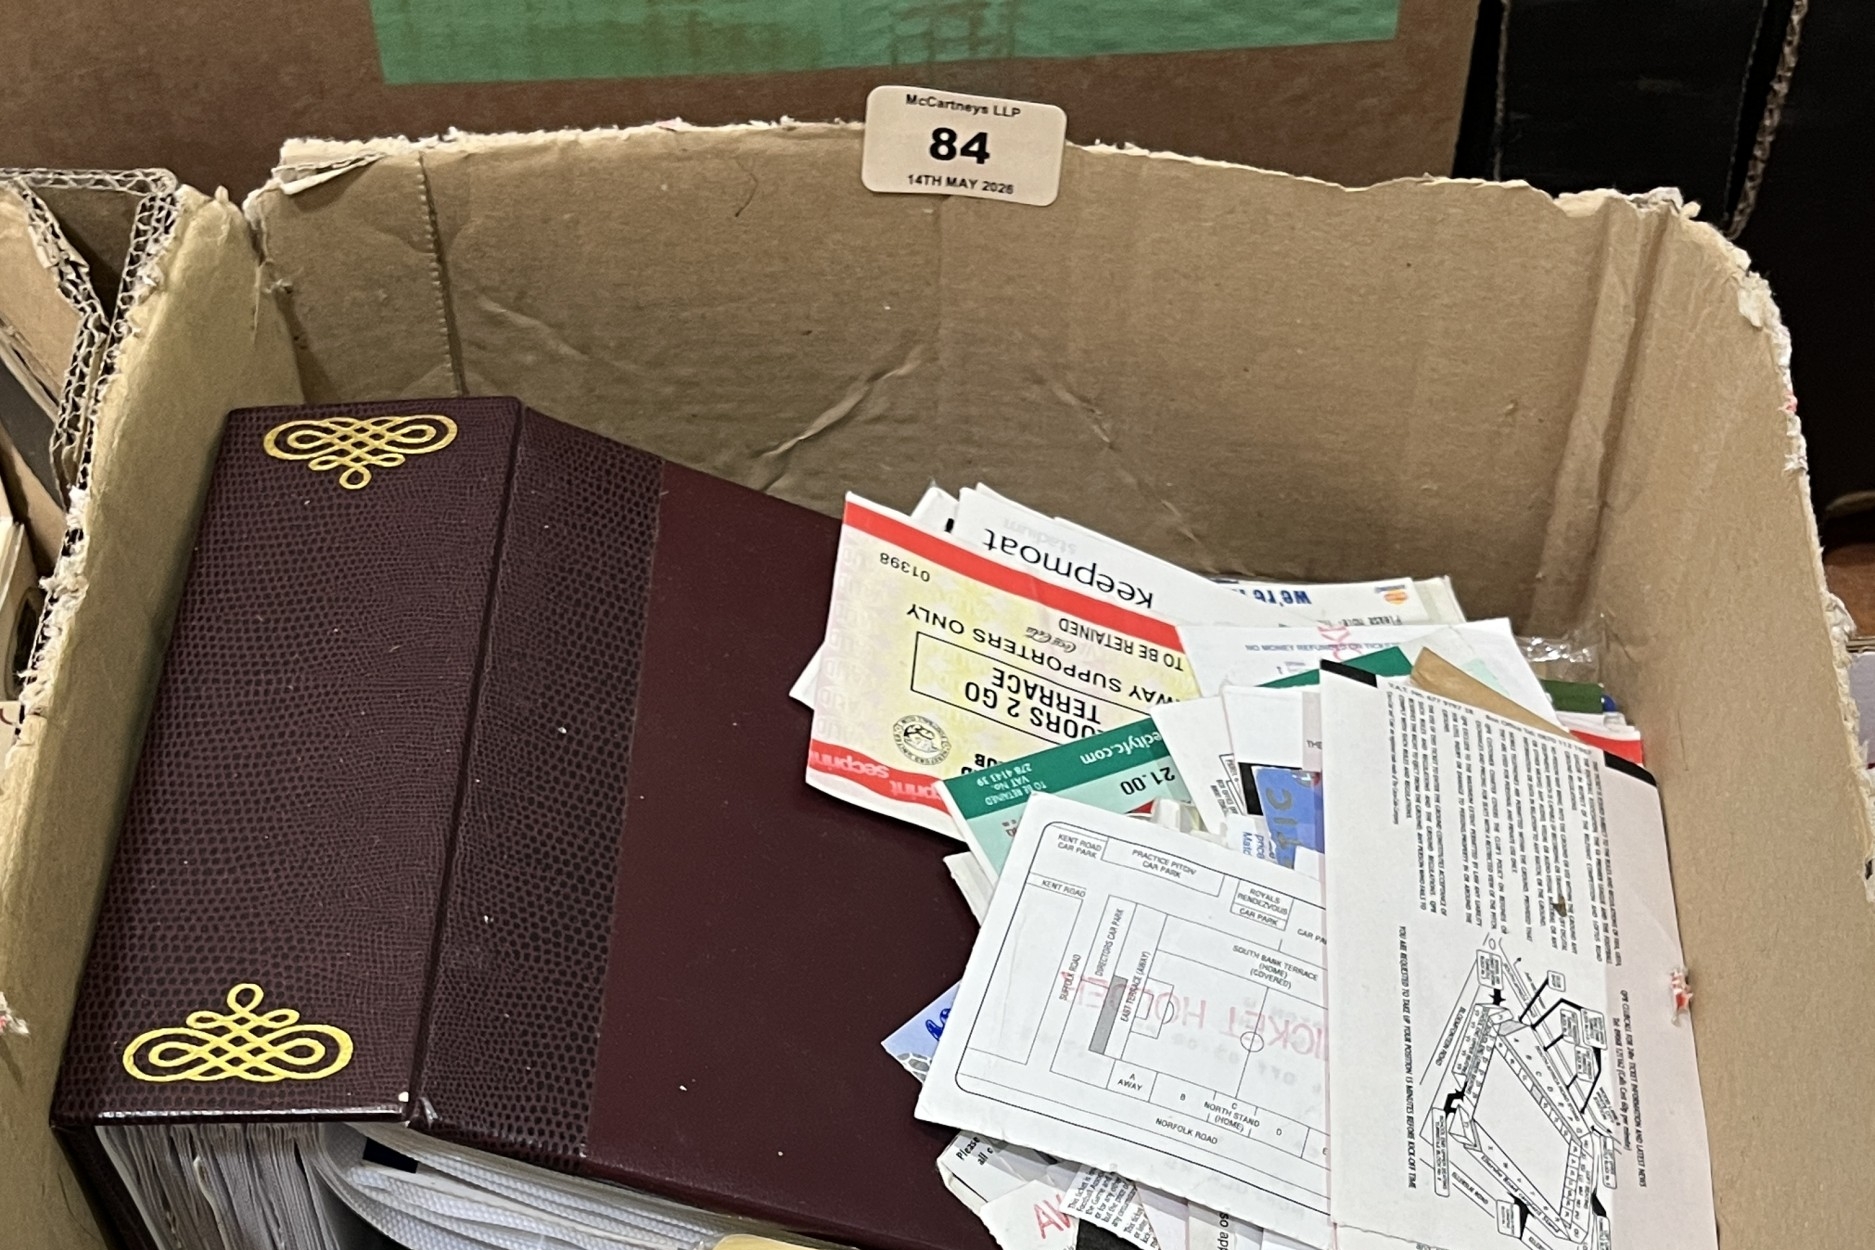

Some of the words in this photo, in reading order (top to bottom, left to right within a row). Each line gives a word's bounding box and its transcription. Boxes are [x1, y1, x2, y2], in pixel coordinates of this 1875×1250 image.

[906, 94, 988, 115] McCartneys
[994, 105, 1021, 117] LLP
[929, 127, 990, 164] 84
[908, 174, 941, 186] 14TH
[946, 177, 978, 189] MAY
[880, 552, 930, 582] 01398
[906, 603, 964, 634] ONLY
[1058, 617, 1134, 655] RETAINED
[972, 628, 1122, 693] SUPPORTERS
[1139, 643, 1158, 661] BE
[1163, 652, 1185, 673] TO
[964, 681, 999, 711] GO
[991, 667, 1102, 723] TERRACE
[1006, 697, 1020, 718] 2
[1030, 705, 1103, 738] OORS
[1080, 730, 1162, 765] ecityfc.com
[1010, 776, 1030, 786] VAT
[1120, 766, 1176, 795] 21.00
[985, 788, 1022, 806] RETAINED
[1057, 834, 1079, 847] KENT
[1080, 840, 1102, 852] ROAD
[1057, 843, 1073, 852] CAR
[1074, 847, 1098, 859] PARK
[1132, 849, 1170, 866] PRACTICE
[1142, 861, 1159, 871] CAR
[1160, 866, 1181, 878] PARK
[1042, 879, 1063, 892] KENT
[1063, 886, 1086, 898] ROAD
[1249, 888, 1281, 905] ROYALS
[1237, 893, 1288, 915] RENDEZVOUS
[1112, 908, 1123, 927] PARK
[1239, 908, 1255, 918] CAR
[1255, 914, 1278, 926] PARK
[1108, 924, 1118, 940] CAR
[1297, 929, 1313, 940] CAR
[1398, 925, 1406, 938] YOU
[1398, 940, 1406, 950] ARE
[1070, 954, 1081, 972] ROAD
[1095, 939, 1114, 977] DIRECTORS
[1233, 946, 1259, 959] SOUTH
[1261, 955, 1282, 967] BANK
[1283, 963, 1318, 981] TERRACE
[1250, 968, 1291, 989] (COVERED)
[1259, 963, 1288, 978] (HOME)
[1399, 952, 1408, 986] REQUESTED
[1400, 988, 1408, 996] TO
[1401, 999, 1409, 1013] TAKE
[1220, 1007, 1326, 1061] ICKET
[1402, 1025, 1410, 1042] YOUR
[1624, 1034, 1633, 1045] FOR
[1403, 1044, 1411, 1073] POSITION
[1627, 1062, 1636, 1082] TICKET
[1117, 1078, 1143, 1091] AWAY
[1404, 1085, 1413, 1113] MINUTES
[1629, 1083, 1640, 1126] INFORMATION
[1204, 1101, 1233, 1119] NORTH
[1233, 1112, 1260, 1128] STAND
[1214, 1115, 1244, 1133] (HOME)
[1155, 1117, 1193, 1136] NORFOLK
[1195, 1132, 1218, 1145] ROAD
[1405, 1116, 1414, 1138] BEFORE
[1634, 1129, 1642, 1143] AND
[956, 1136, 980, 1160] Please
[1406, 1141, 1415, 1170] KICK-OFF
[1635, 1144, 1644, 1166] LATEST
[977, 1154, 988, 1166] all
[1407, 1172, 1416, 1188] TIME
[1638, 1168, 1646, 1186] NEWS
